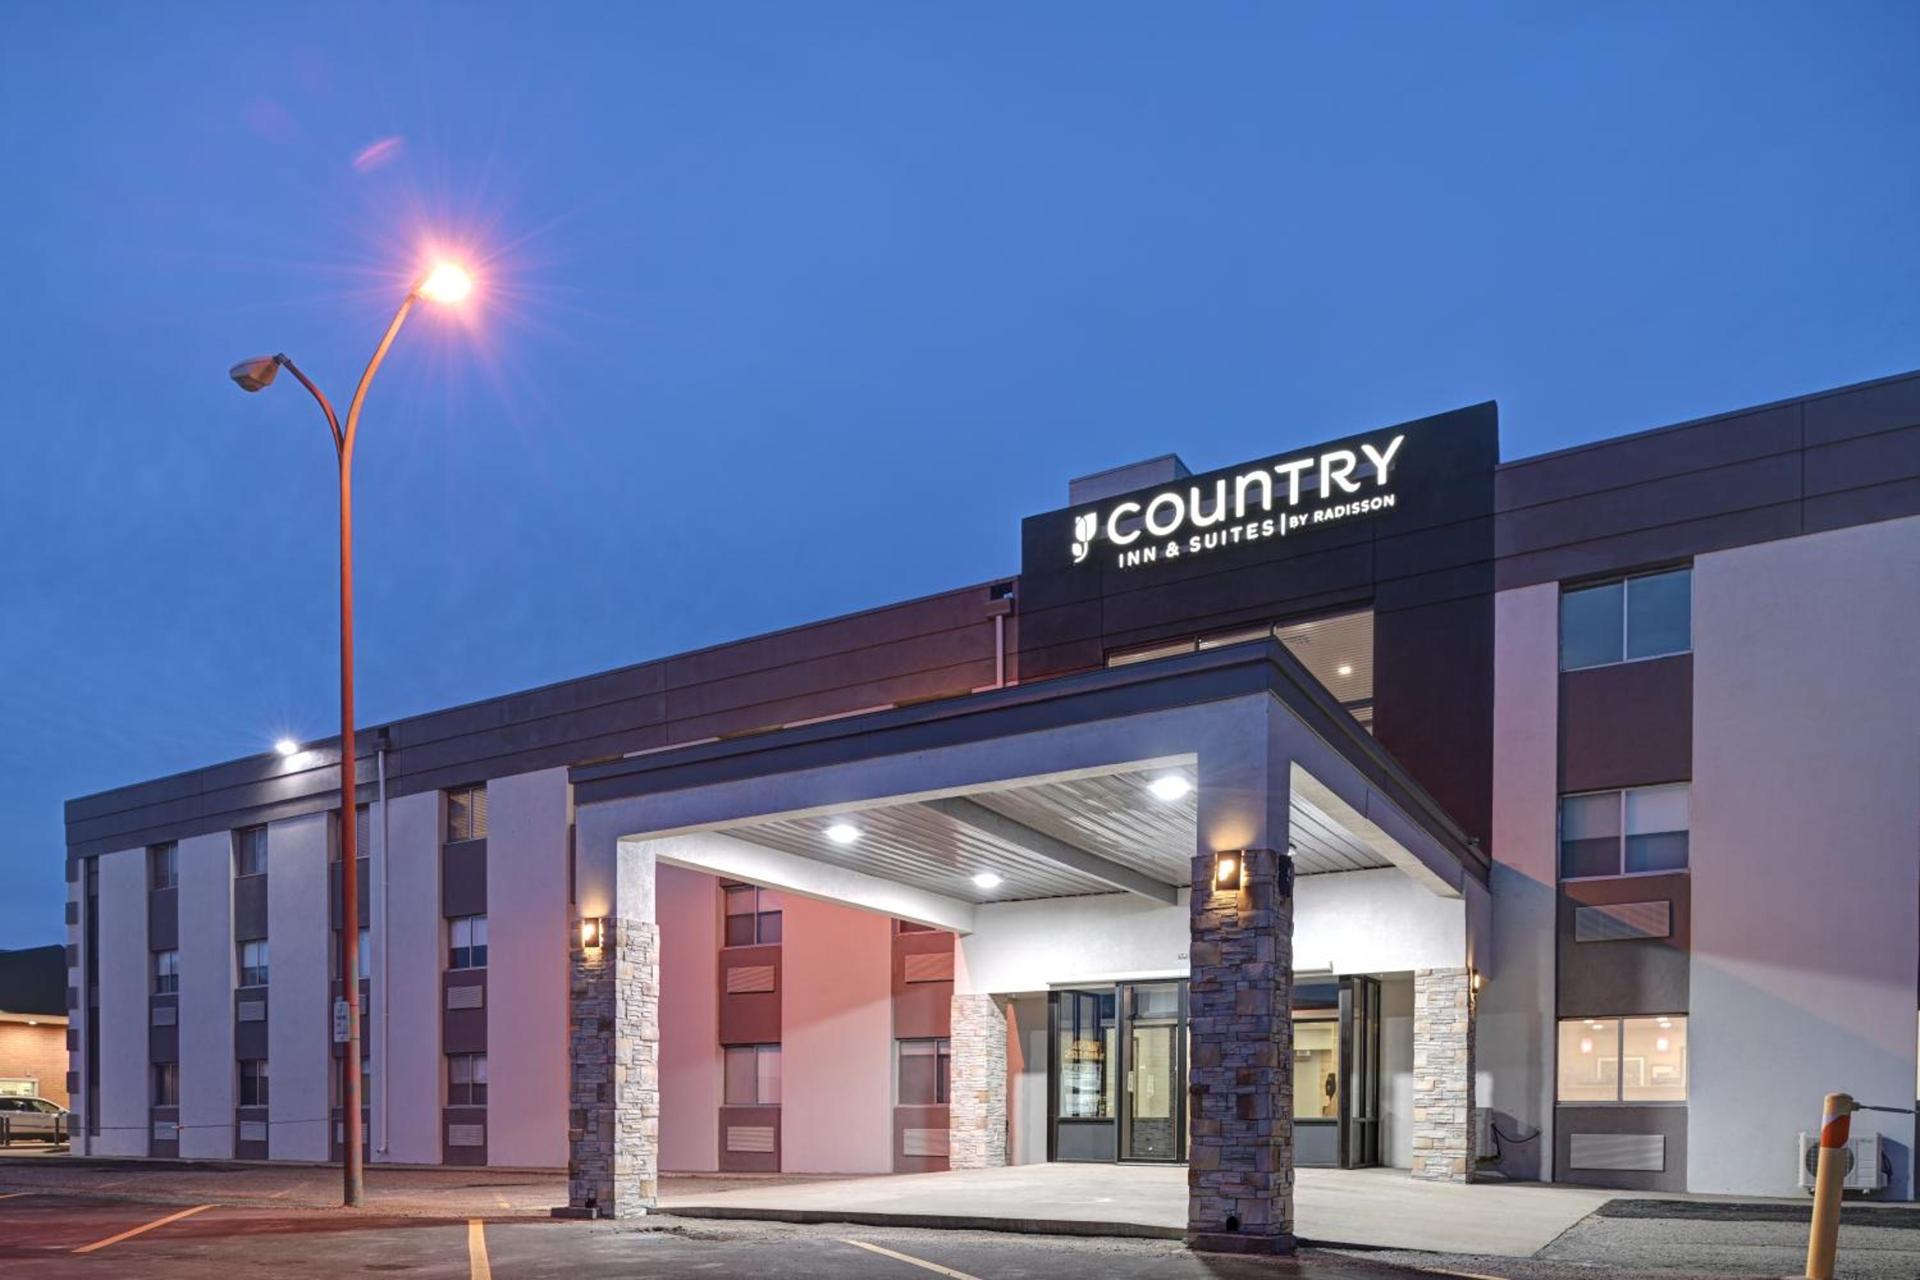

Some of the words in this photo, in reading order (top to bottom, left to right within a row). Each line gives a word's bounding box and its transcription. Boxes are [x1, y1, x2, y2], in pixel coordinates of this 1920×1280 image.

[1118, 546, 1156, 568] INN
[1165, 541, 1180, 558] &
[1189, 519, 1275, 553] SUITES
[1289, 513, 1309, 529] BY
[1313, 494, 1395, 524] RADISSON
